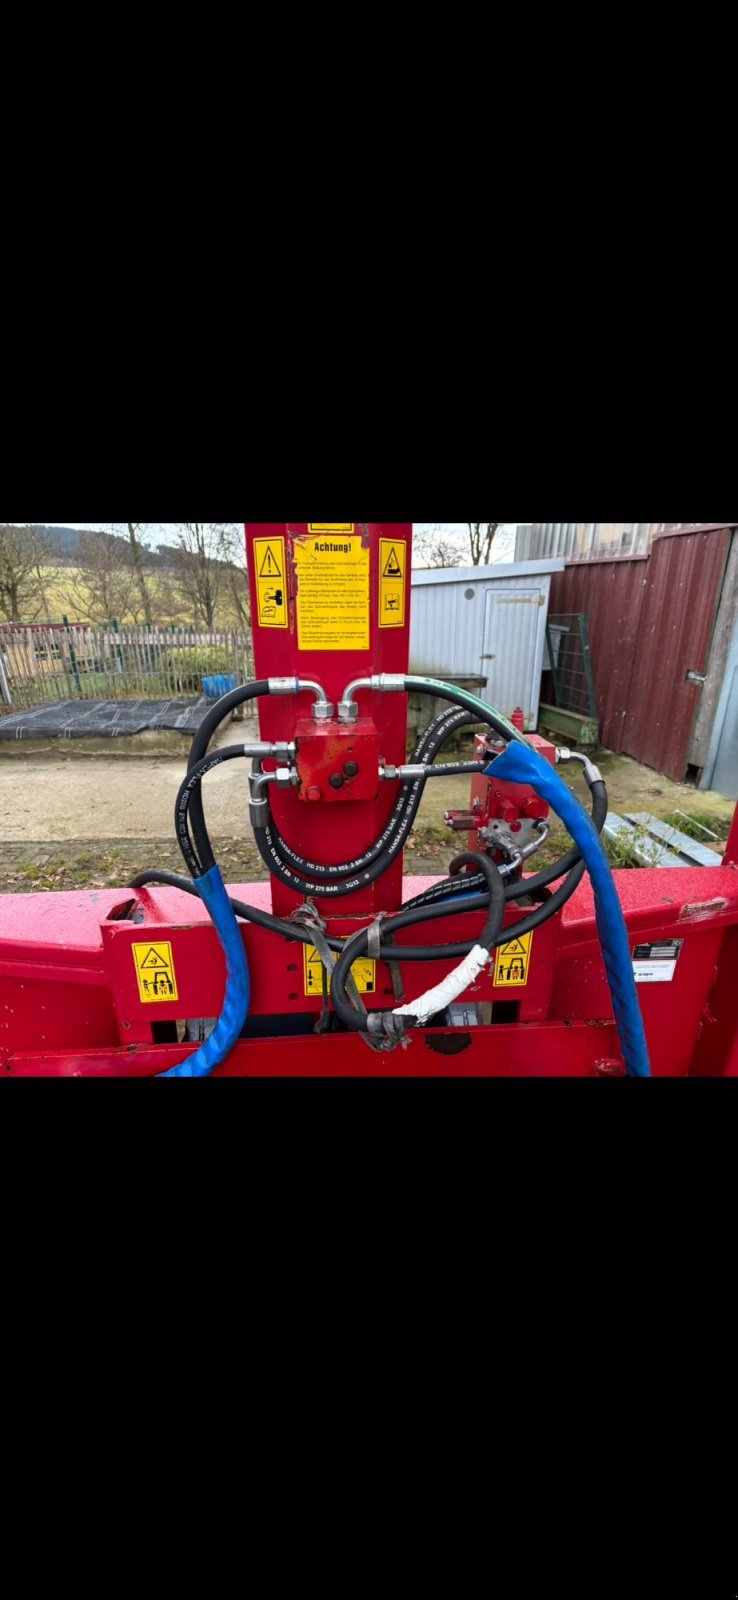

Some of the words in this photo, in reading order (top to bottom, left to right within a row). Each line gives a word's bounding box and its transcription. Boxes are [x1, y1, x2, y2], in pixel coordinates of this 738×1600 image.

[314, 542, 352, 553] Achtung!
[453, 712, 466, 720] BAR
[444, 719, 454, 727] 275
[436, 727, 445, 736] WP
[412, 781, 420, 791] EN
[408, 794, 416, 805] 213
[405, 805, 412, 815] HD
[277, 836, 304, 865] HANSA-FLEX
[338, 864, 348, 872] 853
[354, 858, 363, 866] SN
[375, 839, 383, 849] WP
[381, 831, 391, 841] 275
[388, 817, 397, 831] BAR
